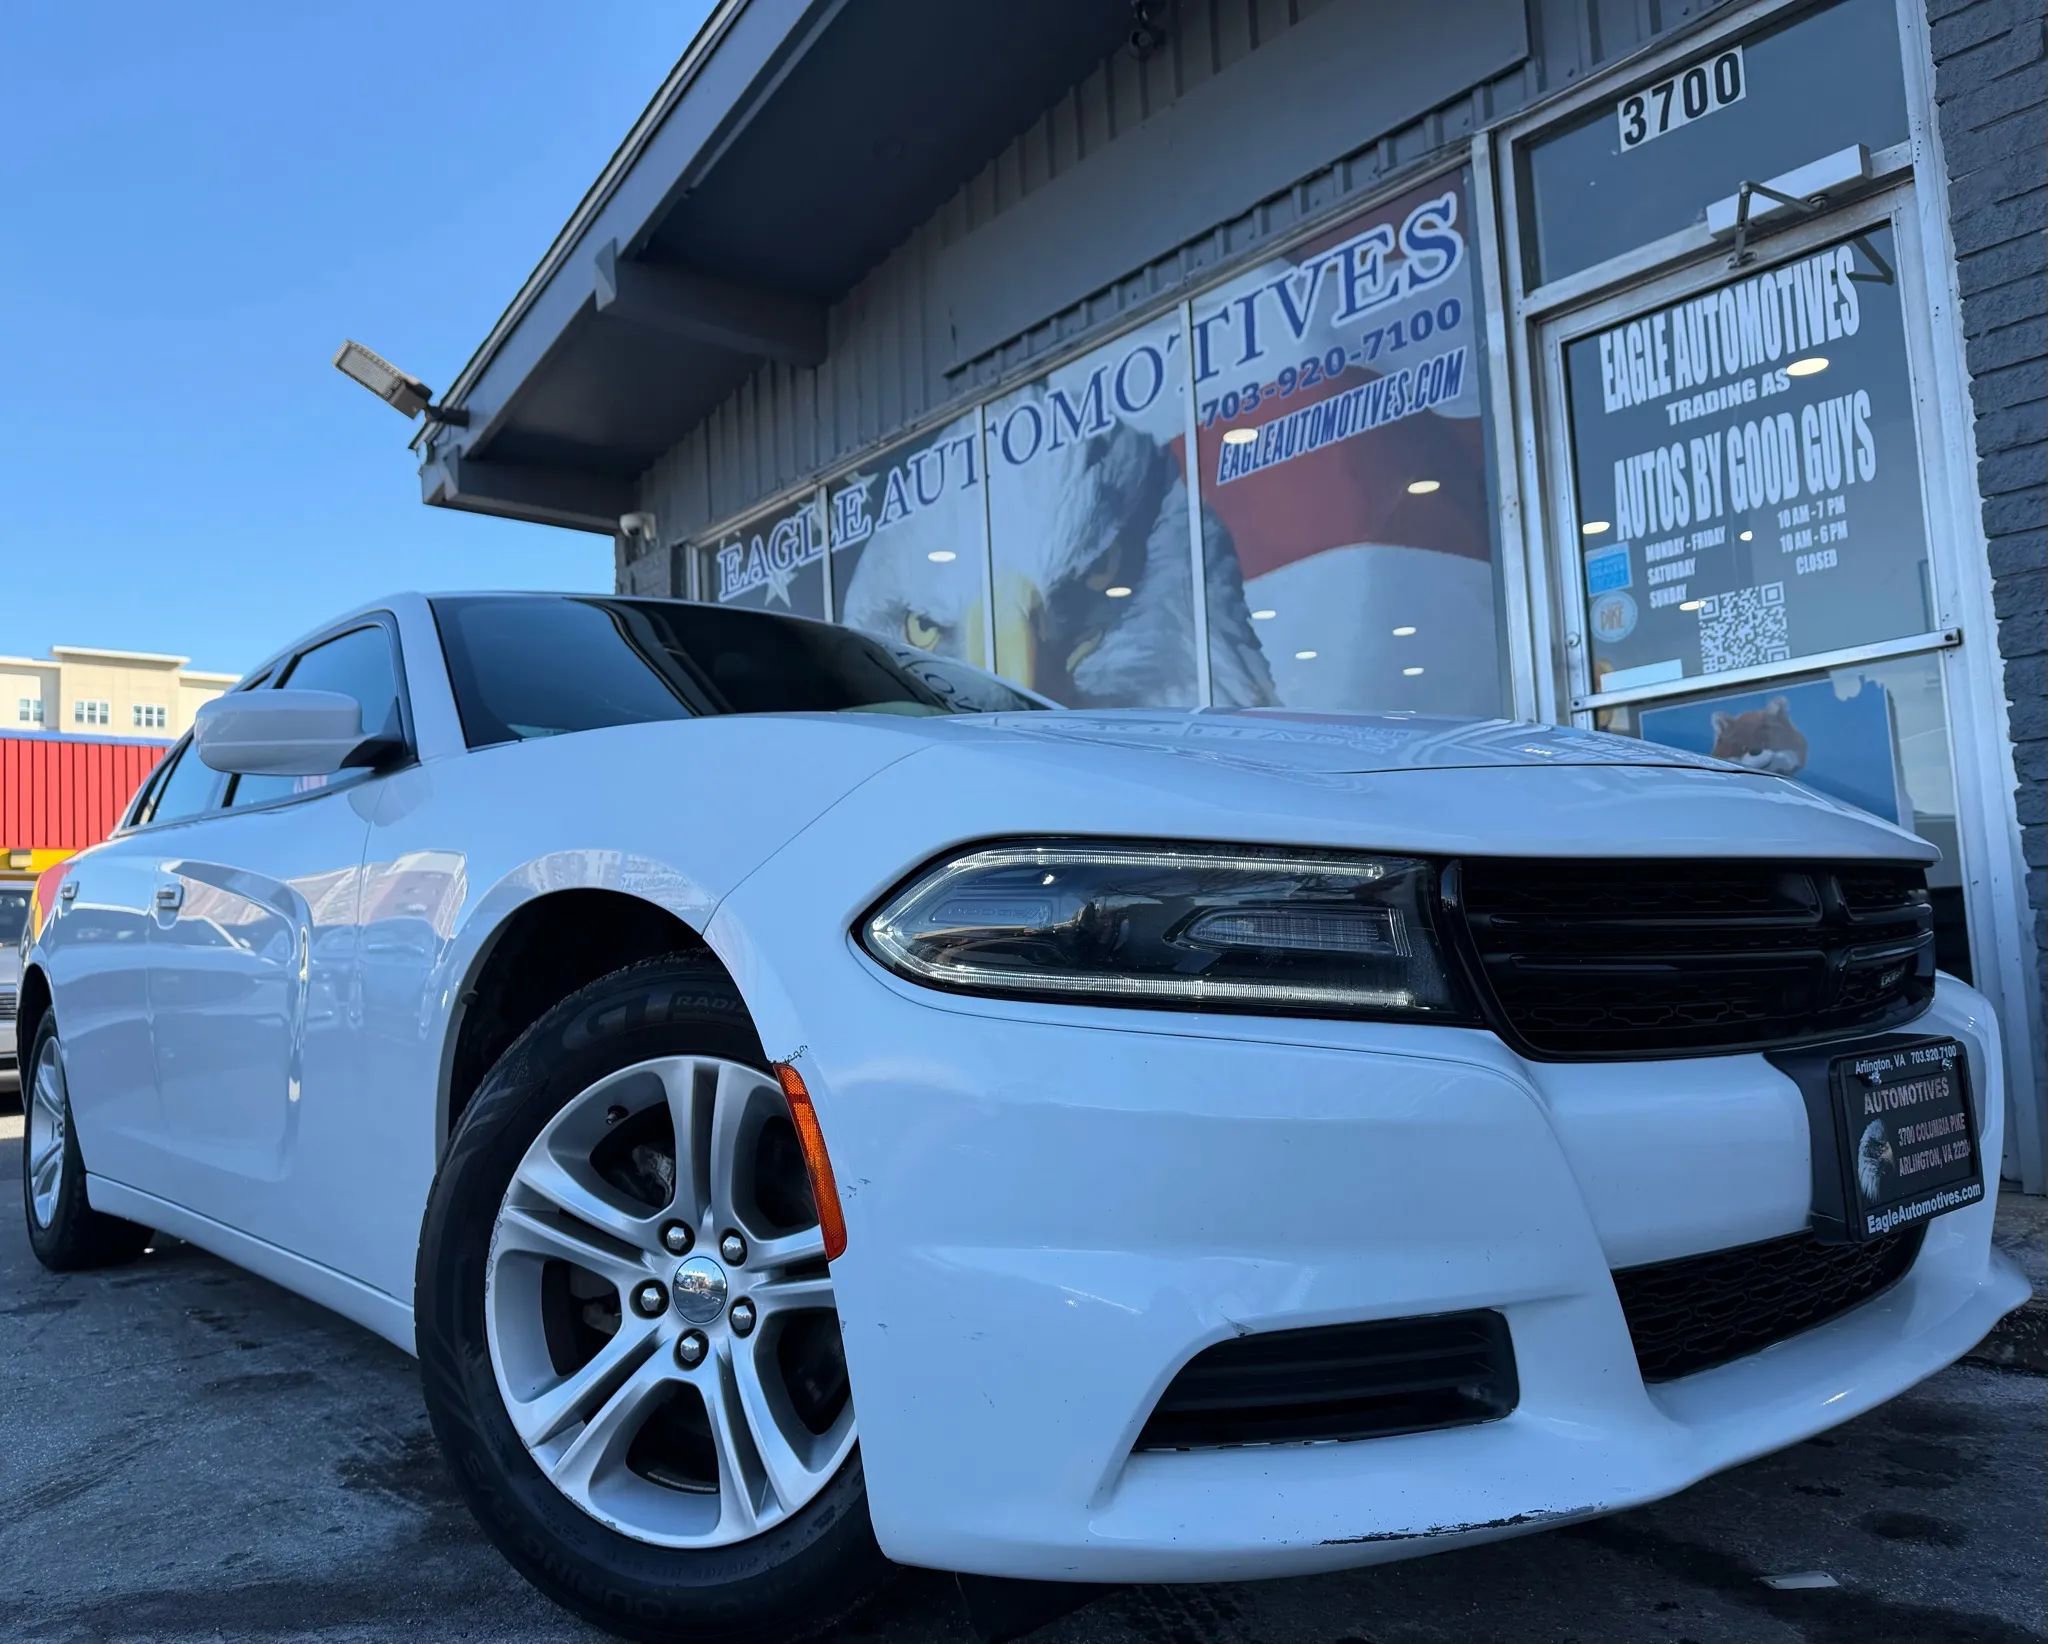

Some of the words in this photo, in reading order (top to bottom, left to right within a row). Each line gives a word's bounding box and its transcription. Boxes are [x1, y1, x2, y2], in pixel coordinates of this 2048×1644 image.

[1622, 52, 1741, 146] 3700
[1599, 313, 1672, 414] EAGLE
[1671, 244, 1861, 389] AUTOMOTIVES
[1202, 298, 1462, 431] 703-920-7100
[718, 484, 872, 602] EAGLE
[876, 191, 1464, 531] AUTOMOTIVES
[1666, 380, 1757, 426] TRADING
[1760, 366, 1791, 399] AS
[1216, 346, 1467, 485] EAGLEAUTOMOTIVES.COM
[1614, 441, 1691, 543] AUTOS
[1689, 431, 1724, 523] BY
[1726, 411, 1800, 515] GOOD
[1801, 389, 1877, 497] GUYS
[1777, 508, 1792, 529] 10
[1792, 504, 1810, 526] AM
[1827, 495, 1847, 516] PM
[1645, 536, 1685, 563] MONDAY
[1691, 525, 1726, 551] FRIDAY
[1779, 533, 1794, 553] 10
[1794, 528, 1812, 550] AM
[1830, 520, 1849, 542] PM
[1647, 557, 1696, 586] SATURDAY
[1795, 549, 1838, 576] CLOSED
[1649, 584, 1687, 609] SUNDAY
[675, 994, 746, 1013] RADI
[1855, 1059, 1894, 1075] Arlington,
[1893, 1054, 1906, 1067] VA
[1910, 1044, 1957, 1064] 703.920.7100
[1864, 1076, 1950, 1115] AUTOMOTIVES
[1898, 1126, 1915, 1146] 3700
[1915, 1117, 1950, 1141] COLUMBIA
[1950, 1112, 1966, 1132] PIKE
[1900, 1147, 1942, 1176] ARLINGTON,
[1942, 1144, 1953, 1163] VA
[1867, 1182, 1981, 1234] EagleAutomotives.com
